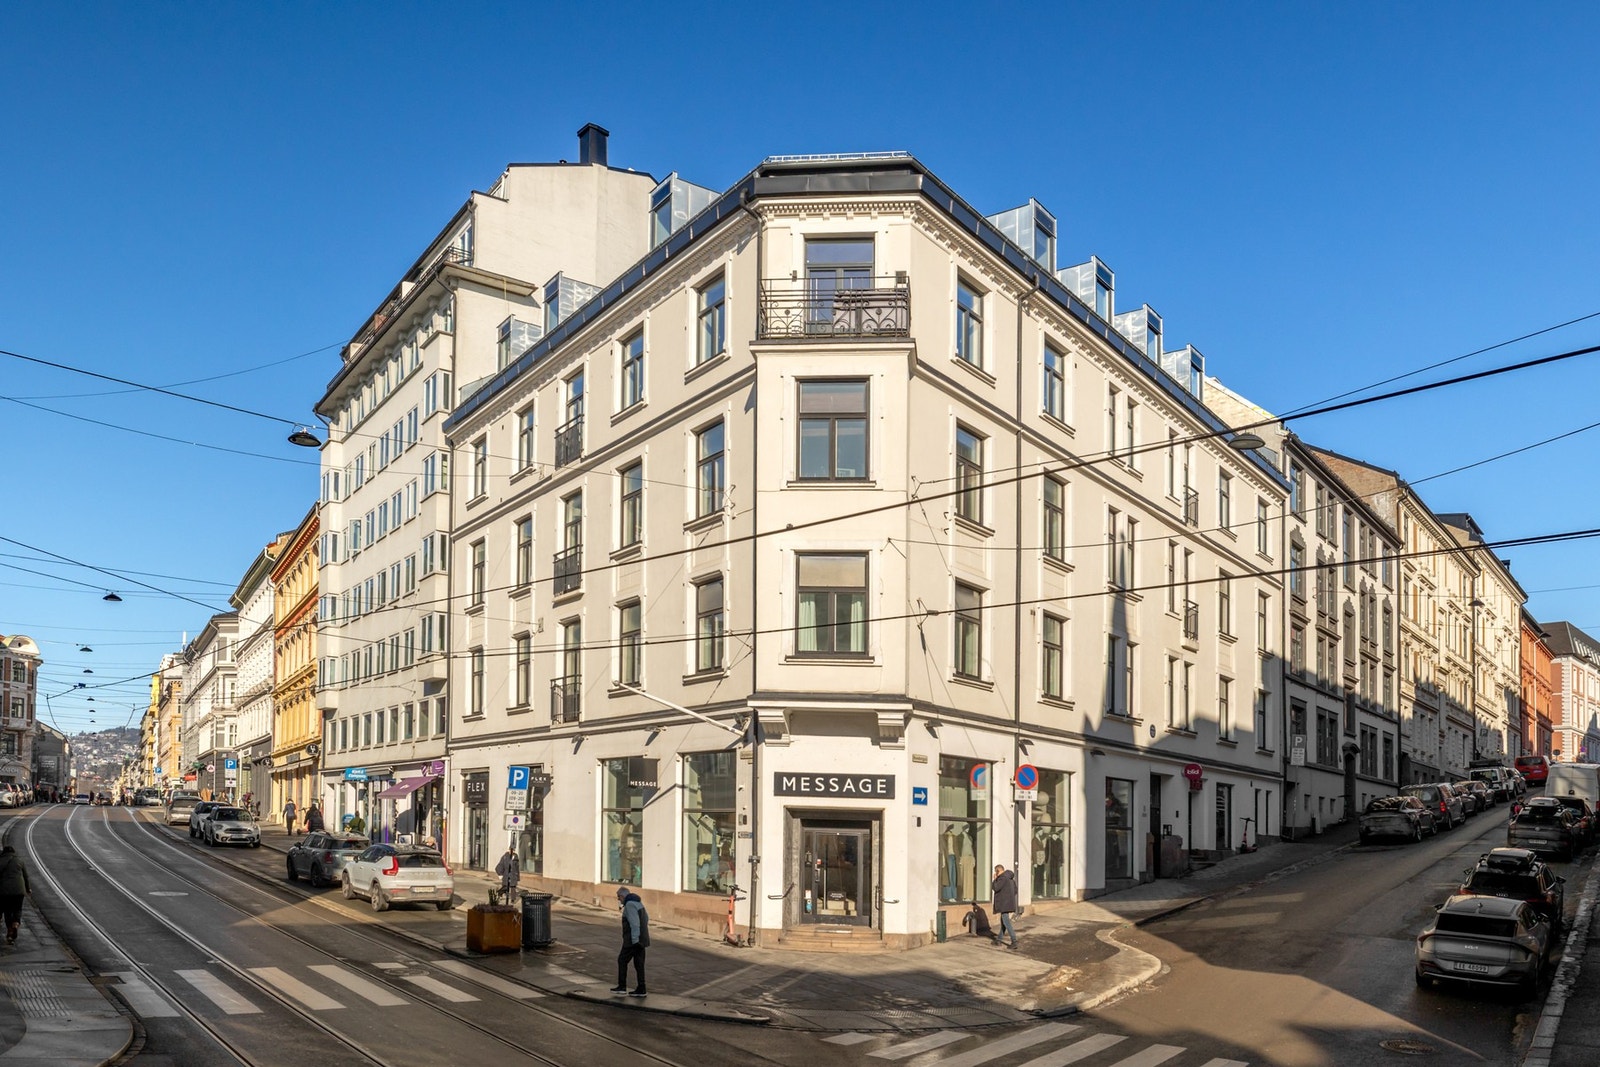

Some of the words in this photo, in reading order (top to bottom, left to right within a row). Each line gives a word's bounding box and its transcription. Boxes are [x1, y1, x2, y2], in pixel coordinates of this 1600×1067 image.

[1295, 736, 1303, 747] P
[227, 760, 234, 768] P
[512, 769, 525, 787] P
[467, 782, 485, 792] FLEX
[782, 776, 887, 793] MESSAGE
